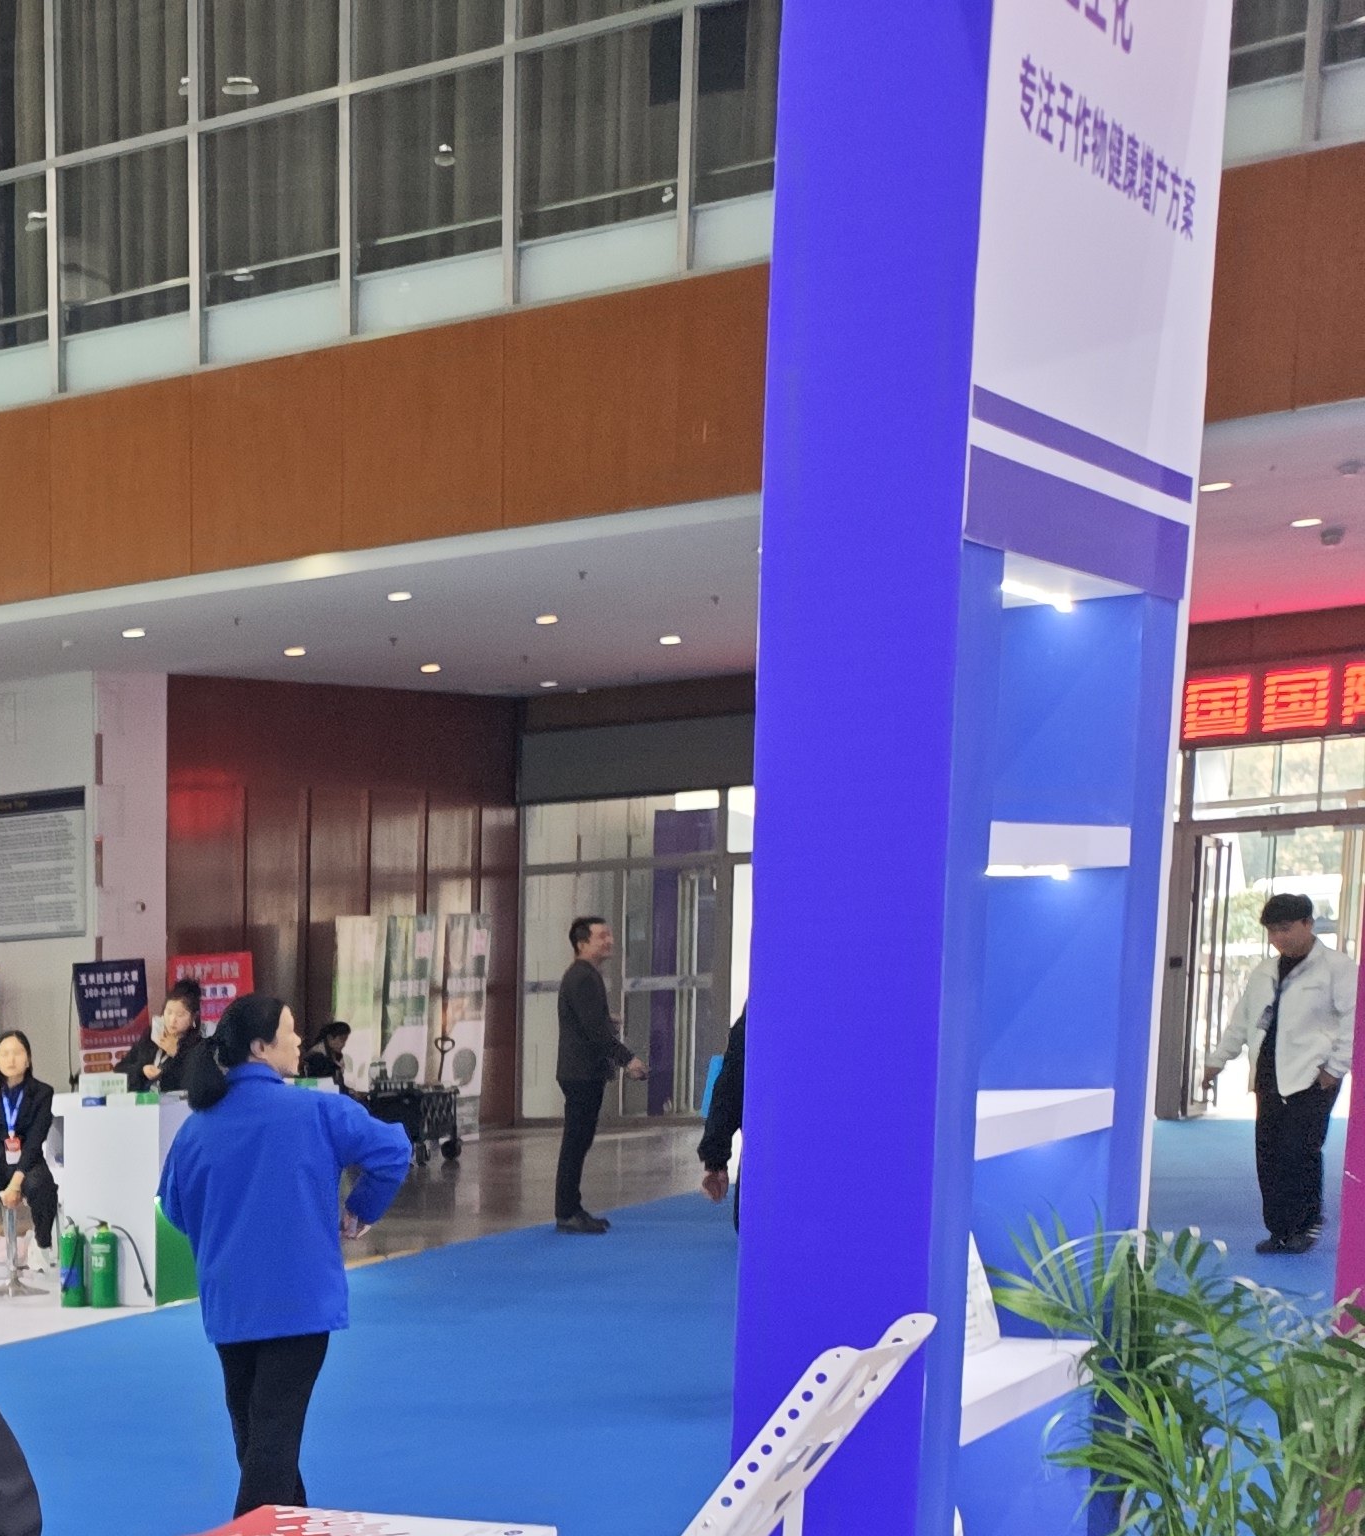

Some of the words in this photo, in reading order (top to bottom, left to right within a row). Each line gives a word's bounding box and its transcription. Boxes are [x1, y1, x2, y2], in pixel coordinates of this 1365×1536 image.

[1019, 53, 1196, 242] 专注于作物健康增产方案
